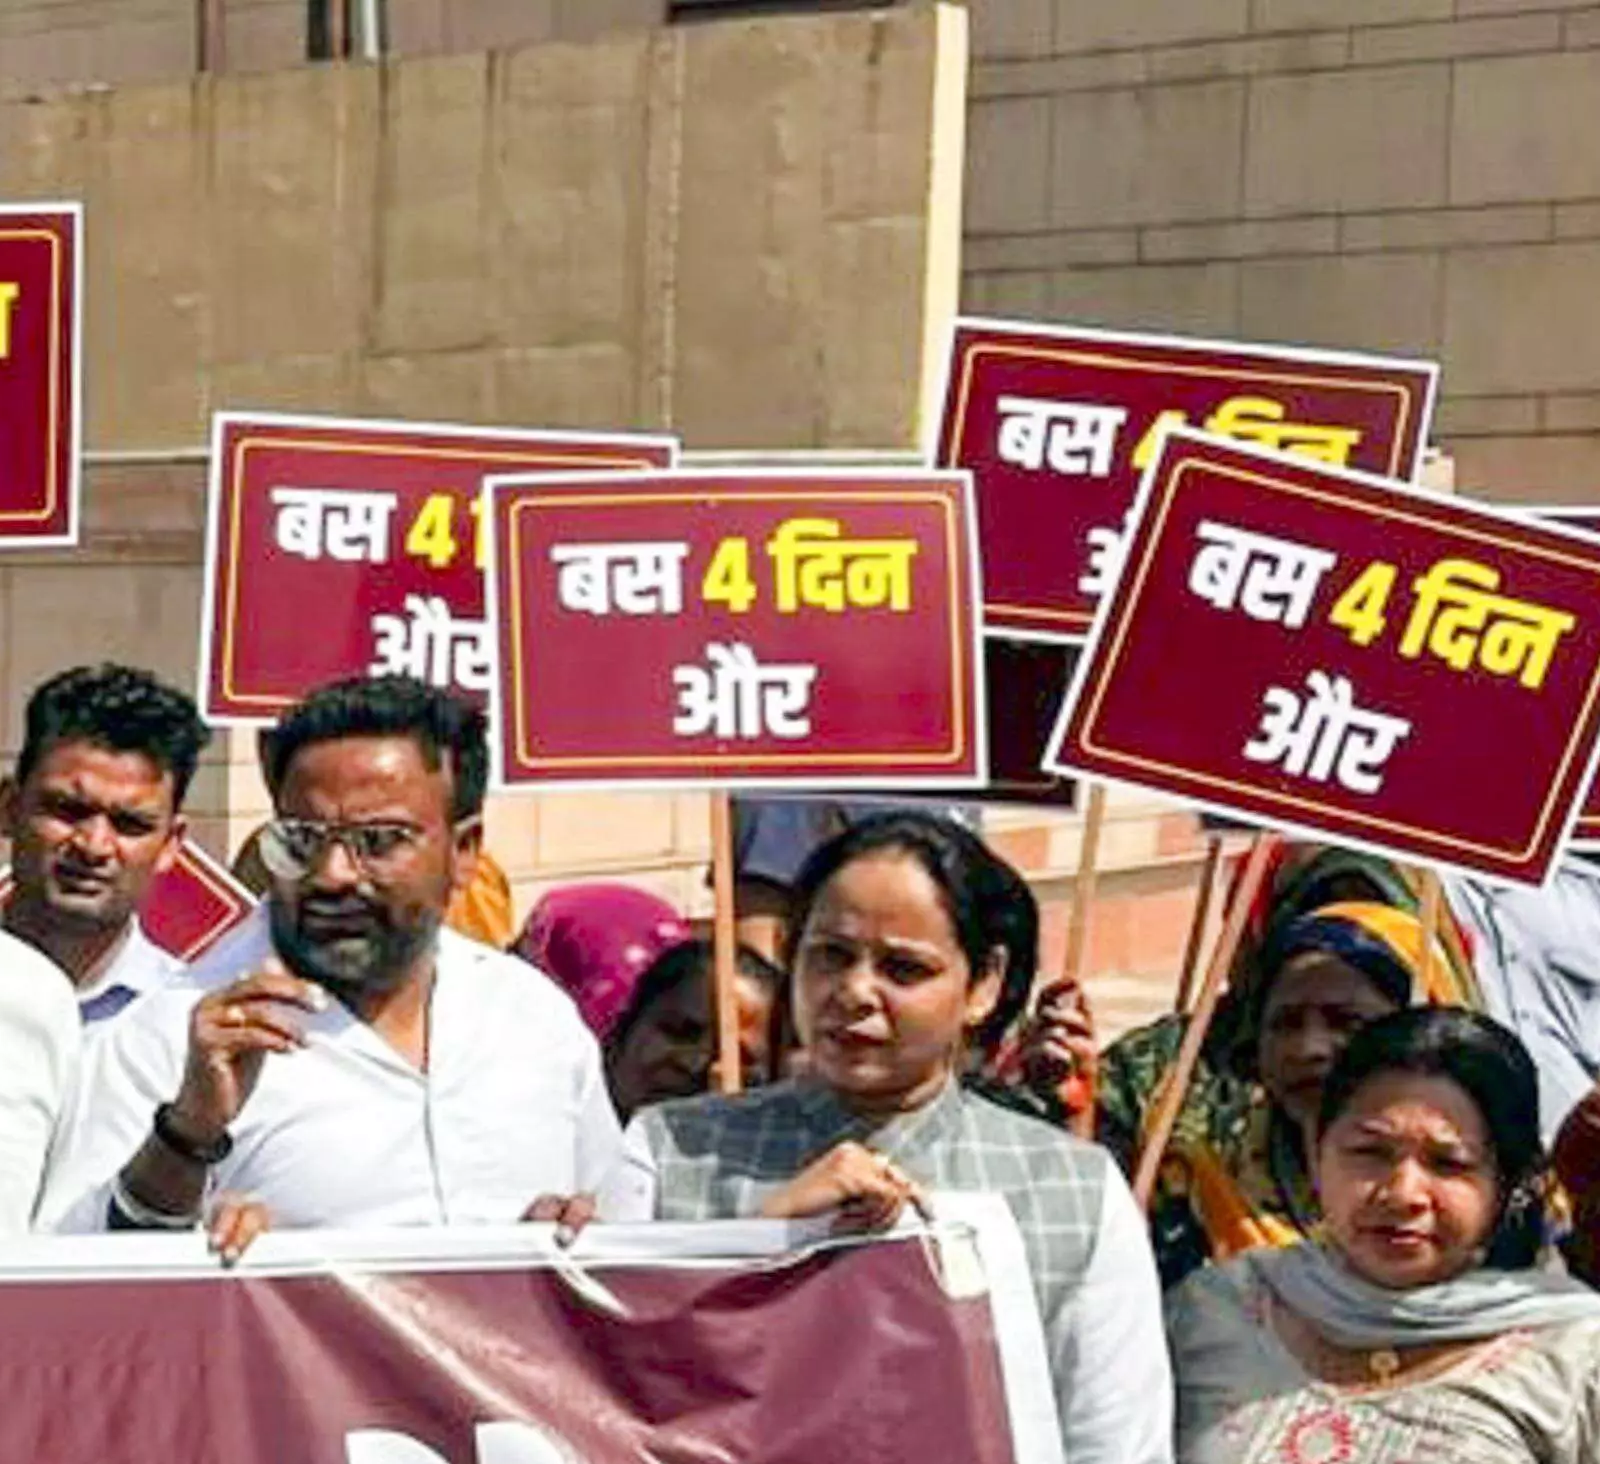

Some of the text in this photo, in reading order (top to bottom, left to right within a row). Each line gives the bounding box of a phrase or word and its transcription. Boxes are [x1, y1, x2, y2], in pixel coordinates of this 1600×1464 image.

[997, 396, 1127, 477] बस
[270, 486, 398, 563] बस
[405, 494, 457, 567] 4
[550, 518, 918, 616] बस 4 दिन
[368, 592, 490, 691] और
[1189, 520, 1336, 628] बस
[1329, 561, 1397, 647] 4
[1400, 559, 1575, 689] दिन
[672, 641, 817, 739] और
[1243, 670, 1410, 794] और
